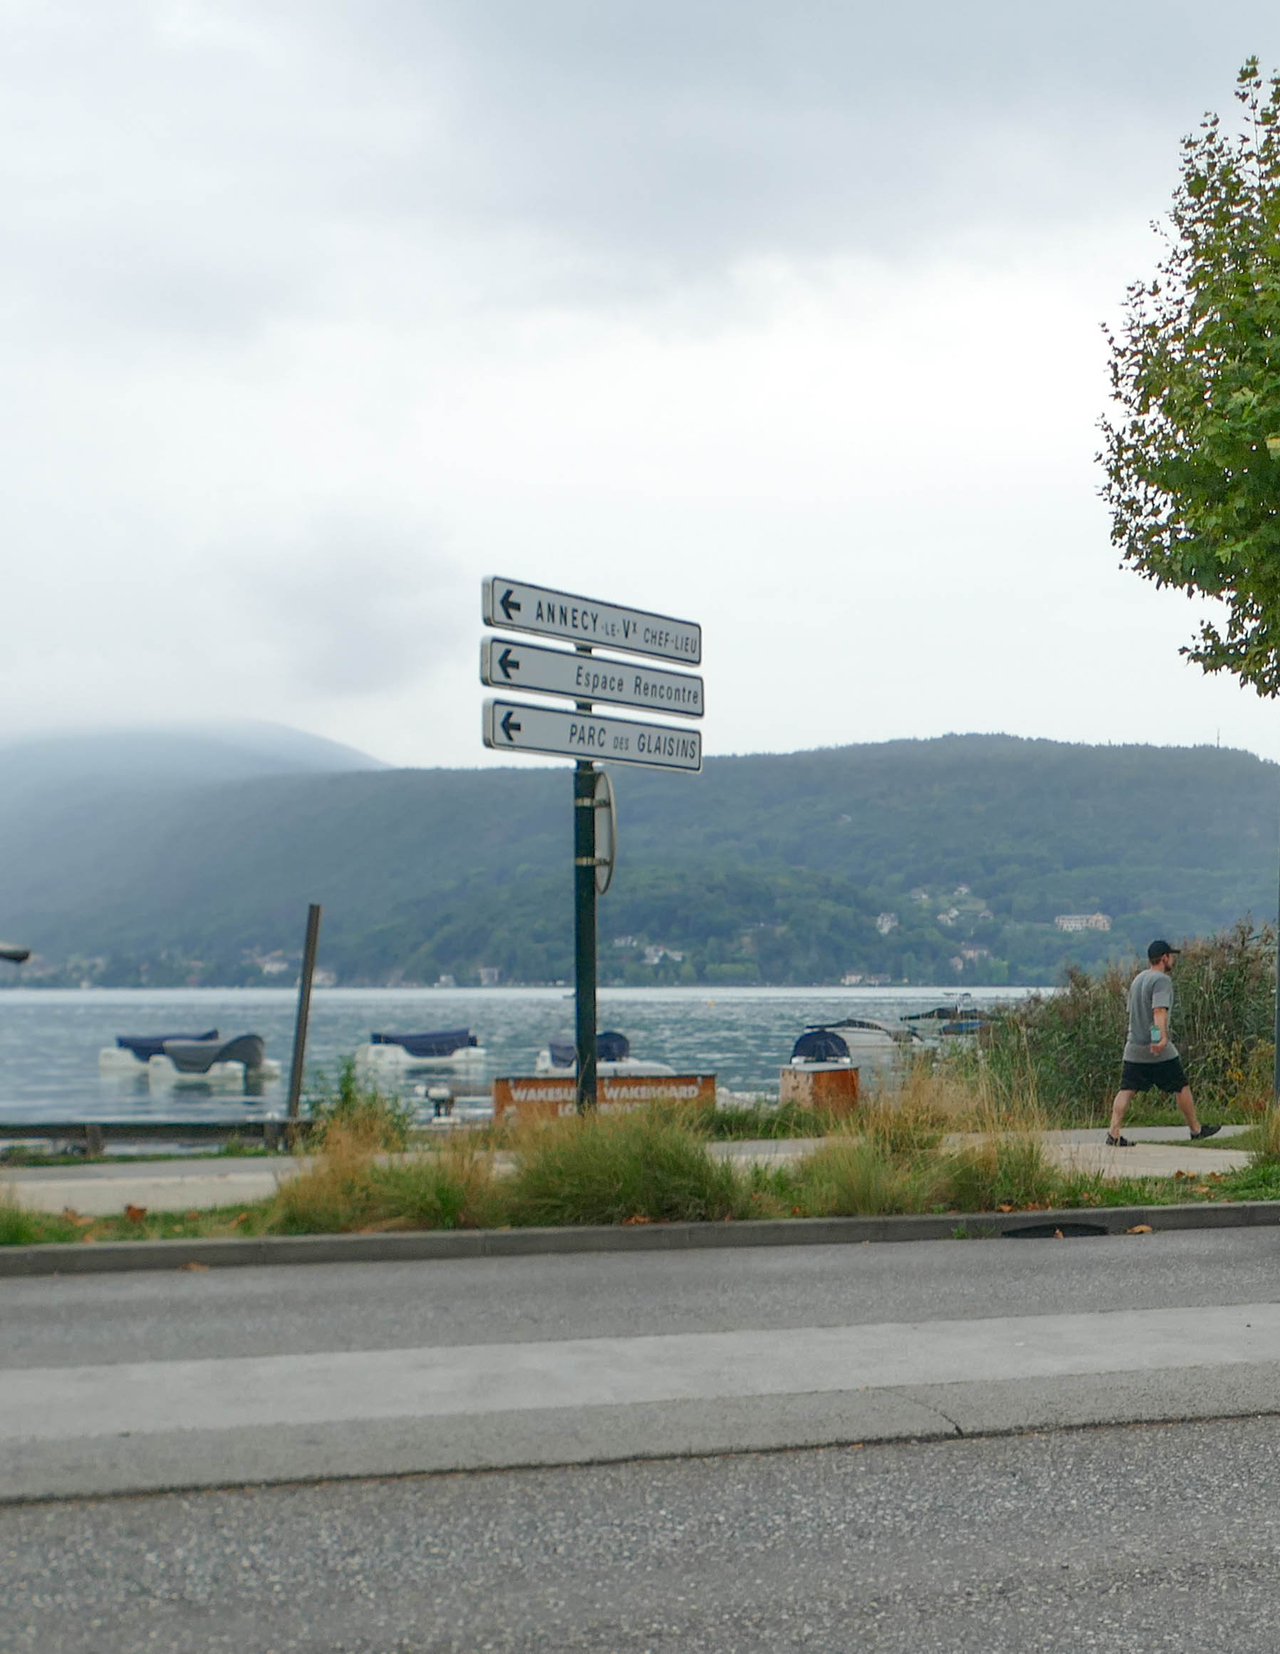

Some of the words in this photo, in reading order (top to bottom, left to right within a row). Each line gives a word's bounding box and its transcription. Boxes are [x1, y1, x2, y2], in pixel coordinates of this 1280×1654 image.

[643, 627, 697, 655] CHEF-LIEU
[575, 665, 624, 693] Espace
[634, 675, 699, 705] Rencontre
[569, 723, 606, 748] PARC
[613, 735, 630, 751] DES
[637, 733, 697, 760] GLAISINS
